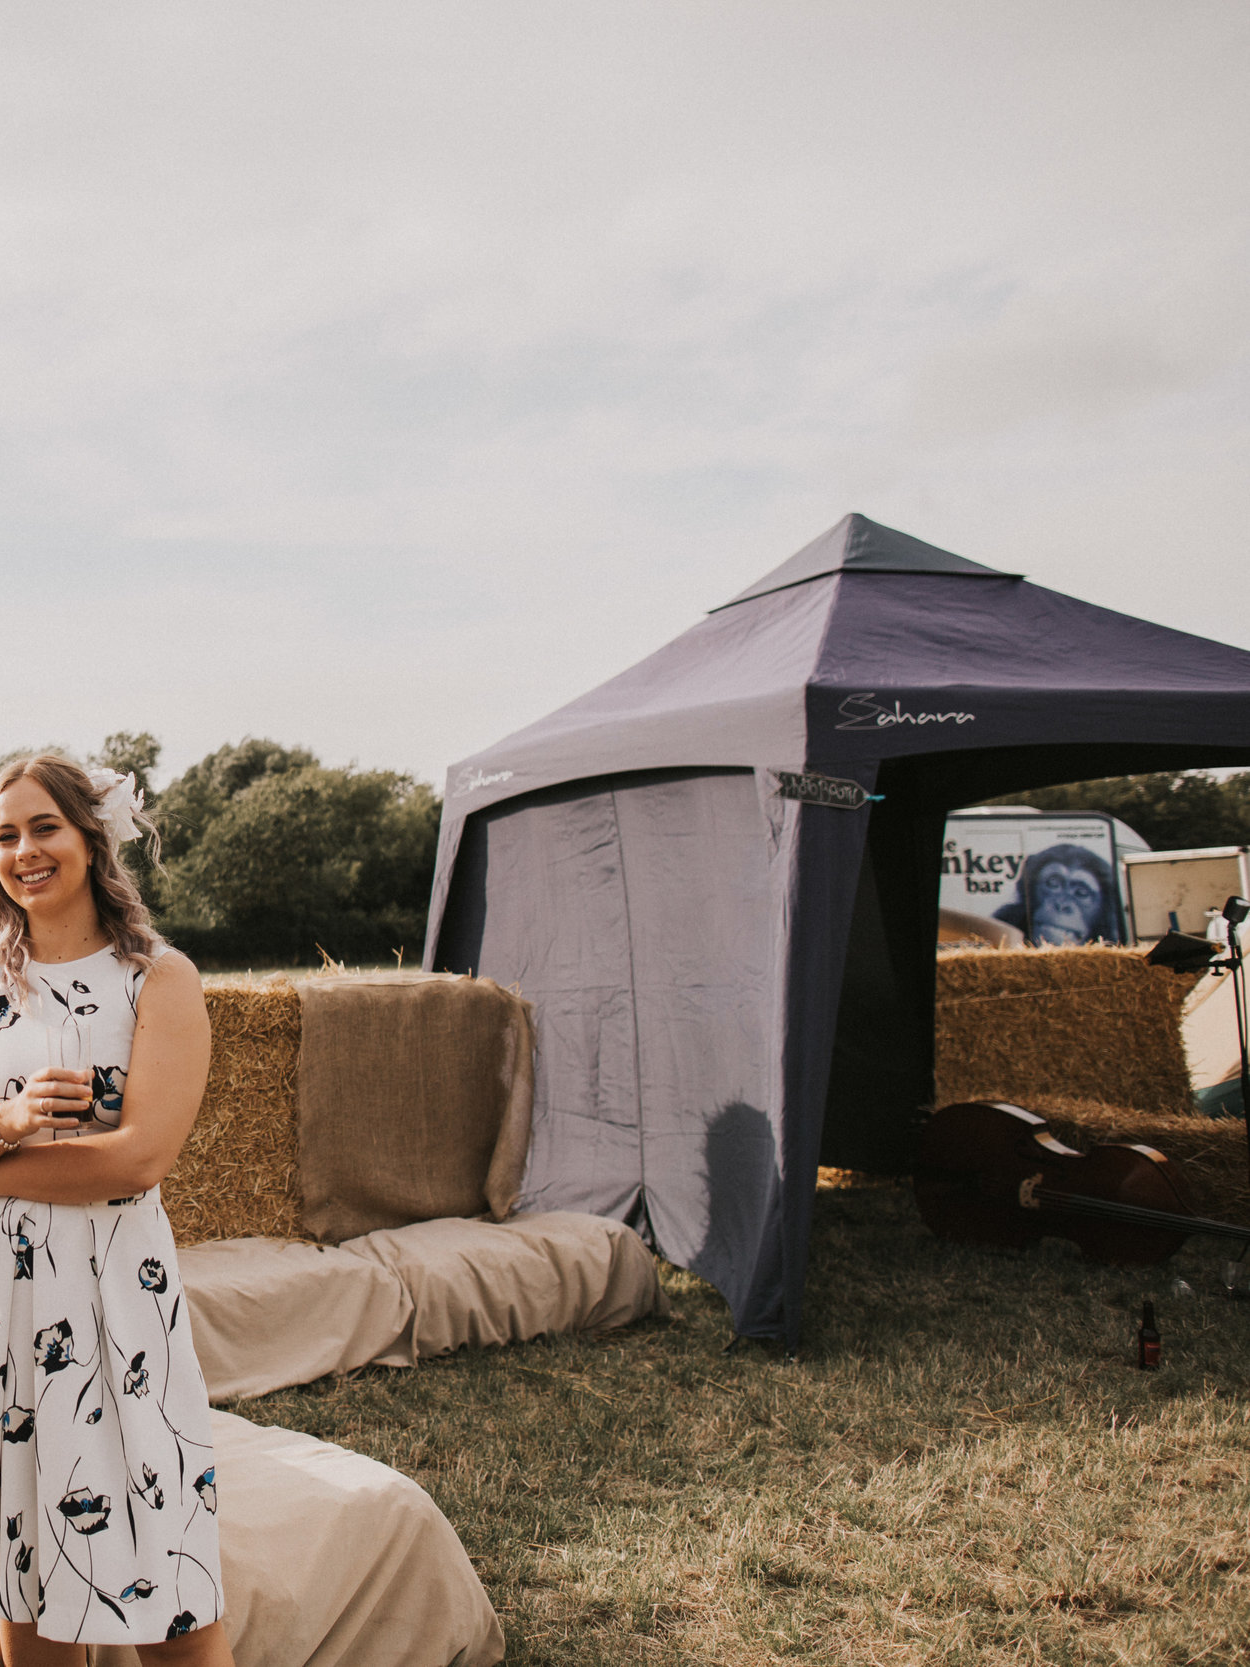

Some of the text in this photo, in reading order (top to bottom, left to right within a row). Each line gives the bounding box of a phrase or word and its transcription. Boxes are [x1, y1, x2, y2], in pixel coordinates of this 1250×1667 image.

[835, 692, 976, 731] Sahara
[941, 848, 1024, 880] nkey
[966, 876, 1004, 893] bar
